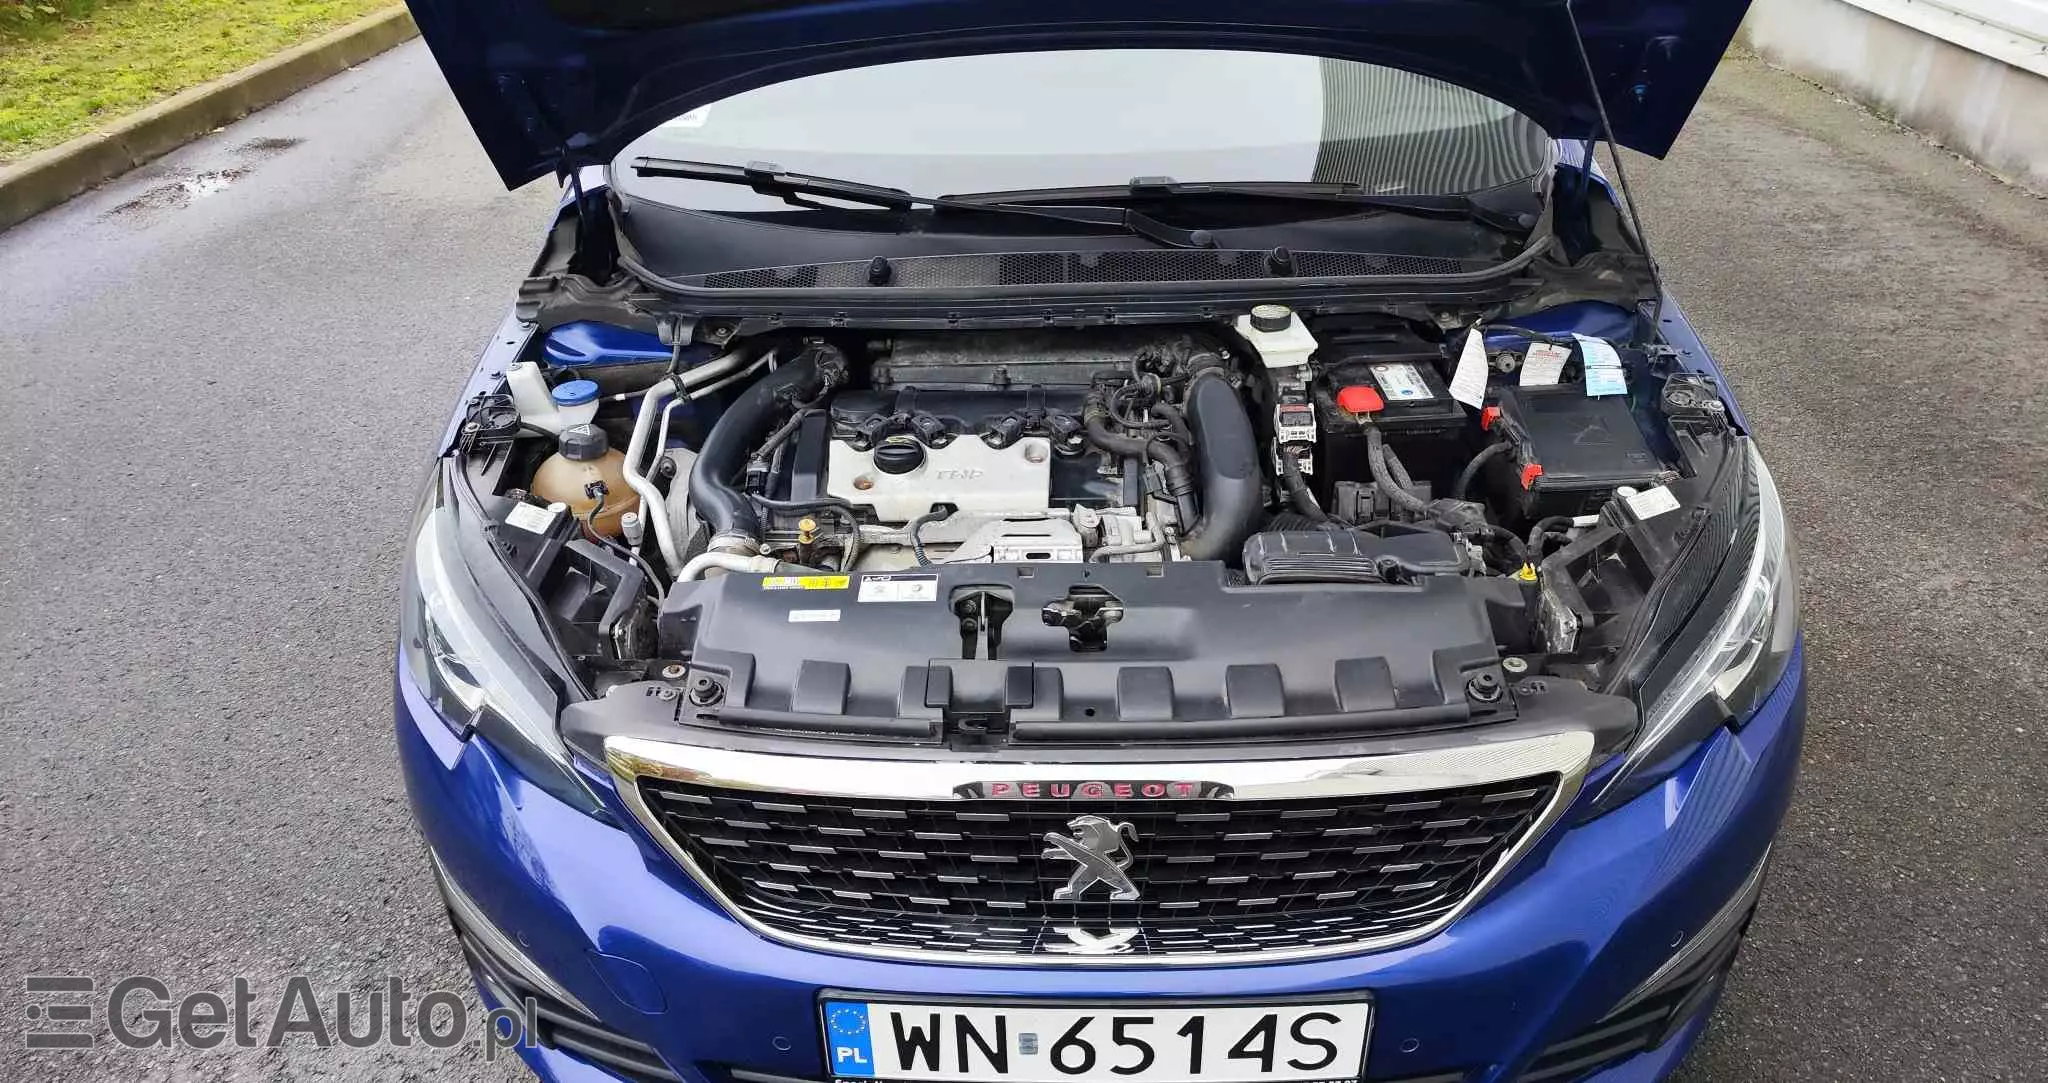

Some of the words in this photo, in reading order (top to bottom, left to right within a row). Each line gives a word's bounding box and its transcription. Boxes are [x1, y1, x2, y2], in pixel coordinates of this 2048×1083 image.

[991, 782, 1195, 798] PEUGEOT
[890, 1011, 1008, 1074] WN
[1049, 1011, 1341, 1075] 6514S
[837, 1046, 867, 1064] PL
